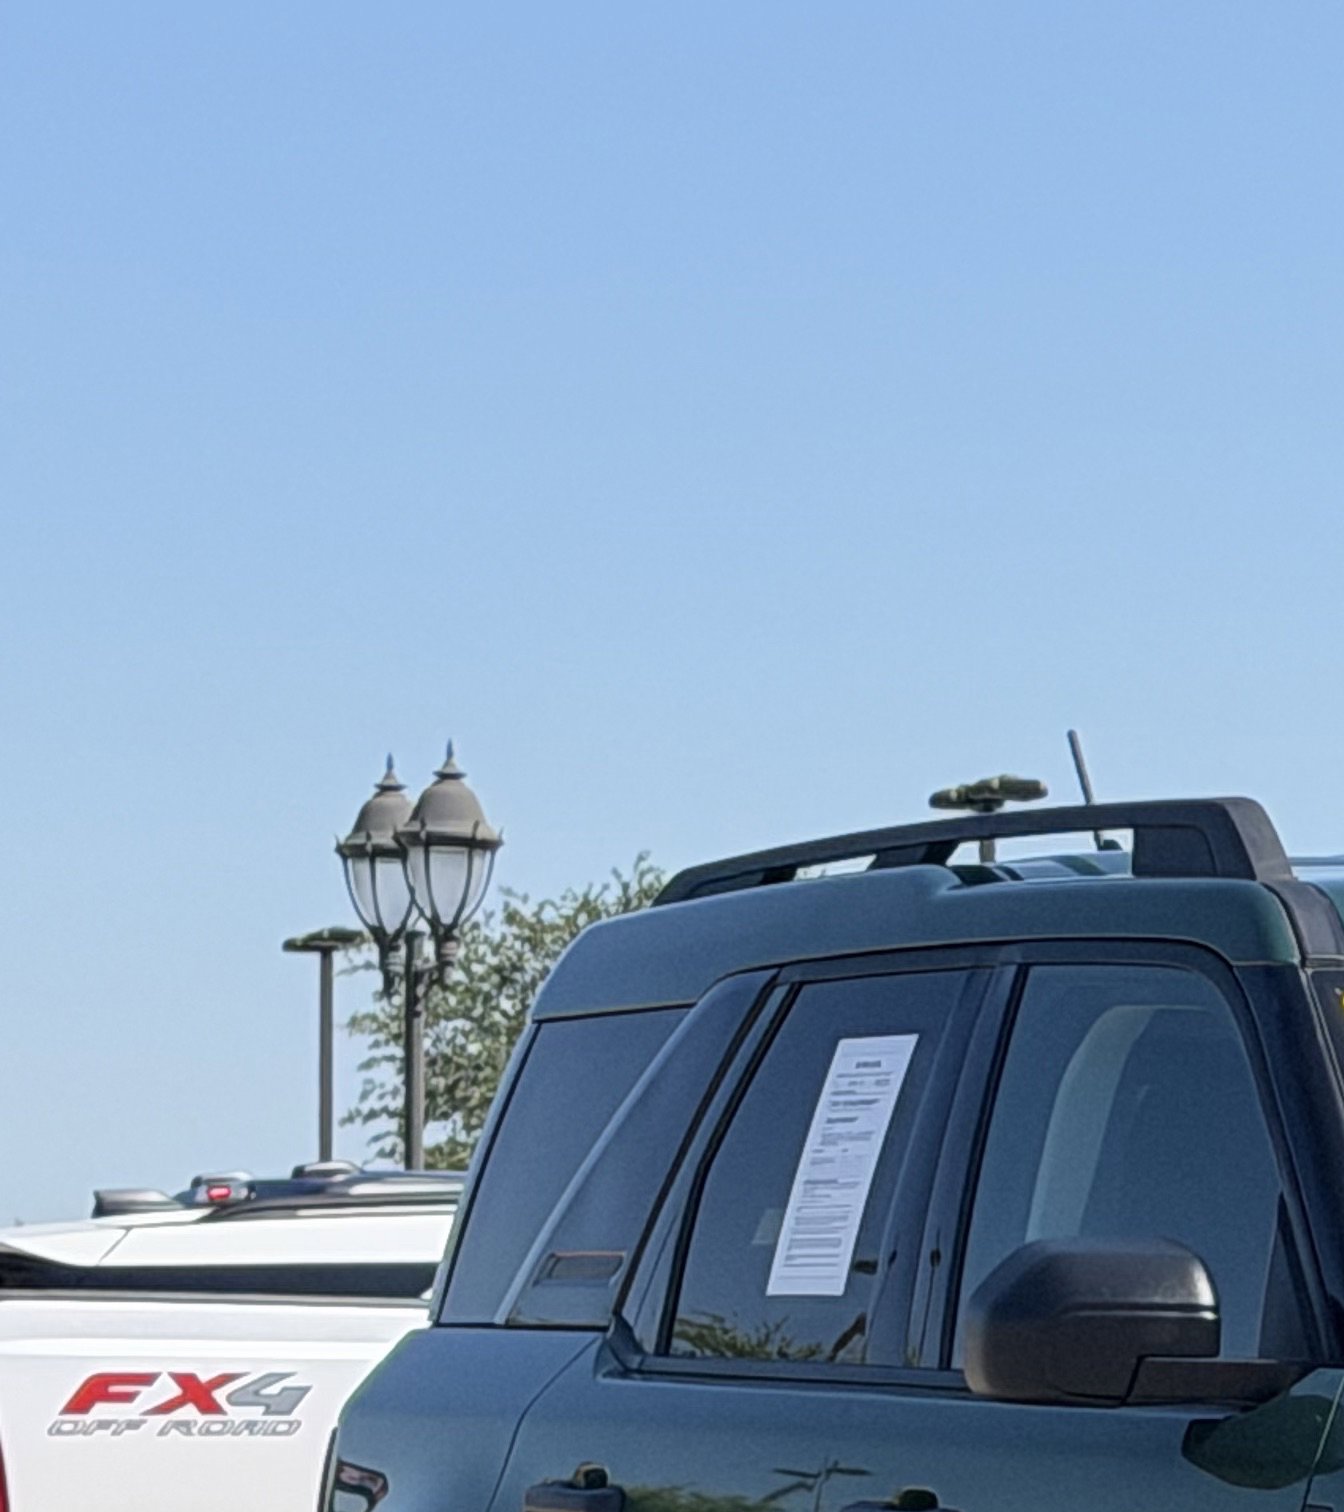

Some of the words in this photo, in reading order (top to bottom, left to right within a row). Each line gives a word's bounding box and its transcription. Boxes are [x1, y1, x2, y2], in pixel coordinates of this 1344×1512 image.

[58, 1371, 313, 1416] FX4
[47, 1418, 148, 1437] OFF
[156, 1418, 303, 1437] ROAD
